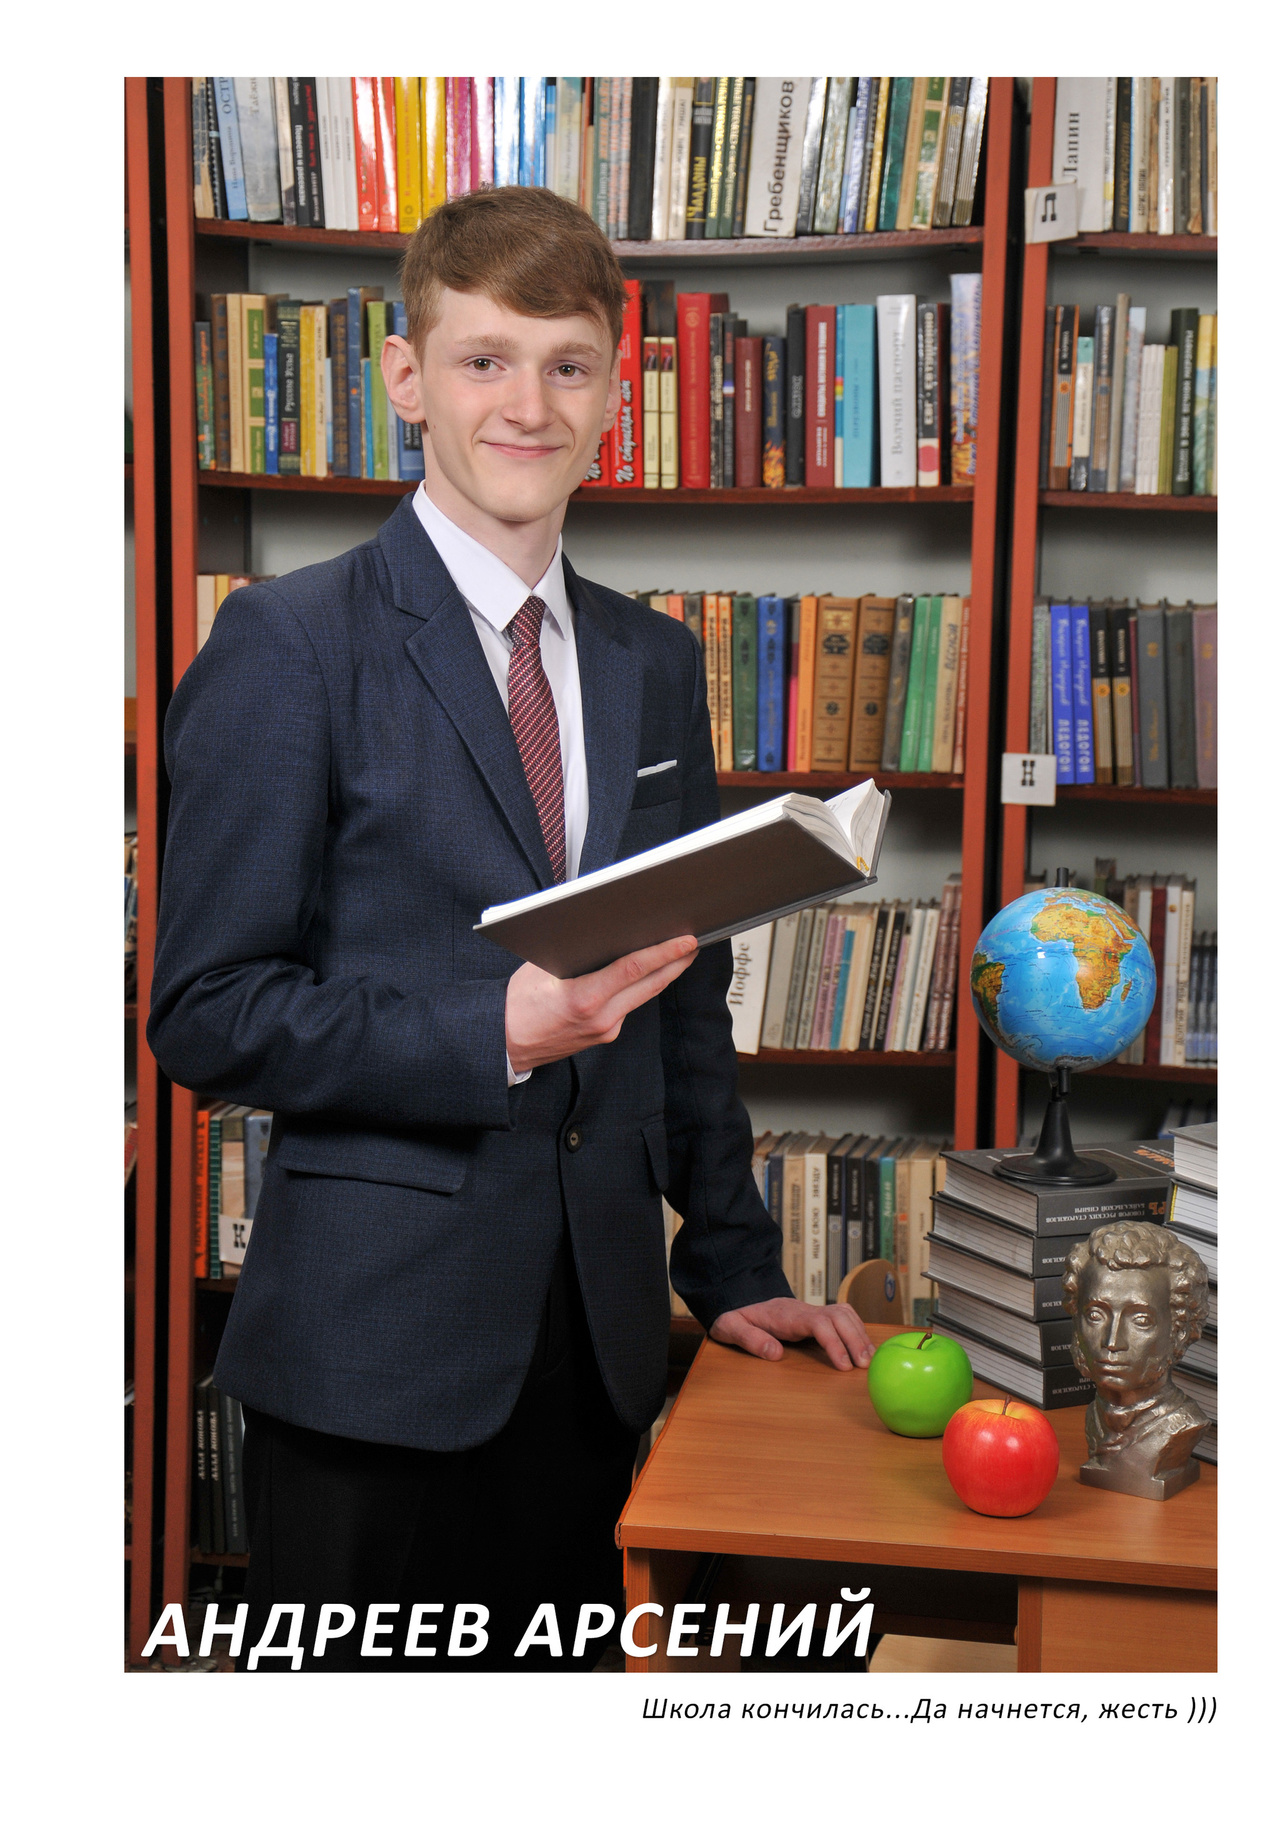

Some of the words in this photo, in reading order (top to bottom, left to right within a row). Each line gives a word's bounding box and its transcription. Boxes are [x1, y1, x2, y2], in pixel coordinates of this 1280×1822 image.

[715, 105, 726, 144] СТОРОНА
[763, 80, 794, 233] Гребенщиков
[1061, 112, 1080, 185] Лапин
[1041, 192, 1057, 223] Л
[891, 330, 906, 395] паспорт
[923, 312, 935, 391] ЕВТУШЕНКО
[1184, 329, 1194, 379] МЕРЗЛОТЫ
[620, 380, 632, 403] лет
[1182, 380, 1192, 414] ВЕЧНОЙ
[890, 397, 904, 456] Волчий
[923, 400, 934, 426] ЕВГ
[615, 465, 634, 483] По
[1021, 760, 1035, 787] Н
[729, 942, 752, 1007] Иоффе
[812, 1167, 822, 1199] ЗВЕЗДУ
[812, 1206, 821, 1235] СВОЮ
[1045, 1214, 1087, 1223] СТАРОЖИЛОВ
[1088, 1212, 1117, 1220] РУССКИХ
[1100, 1203, 1145, 1212] БАЙКАЛЬСКОЙ
[1118, 1210, 1145, 1218] ГОВОРОВ
[812, 1238, 821, 1260] ИЩУ
[1052, 1384, 1091, 1394] СТАРОЖИЛОВ
